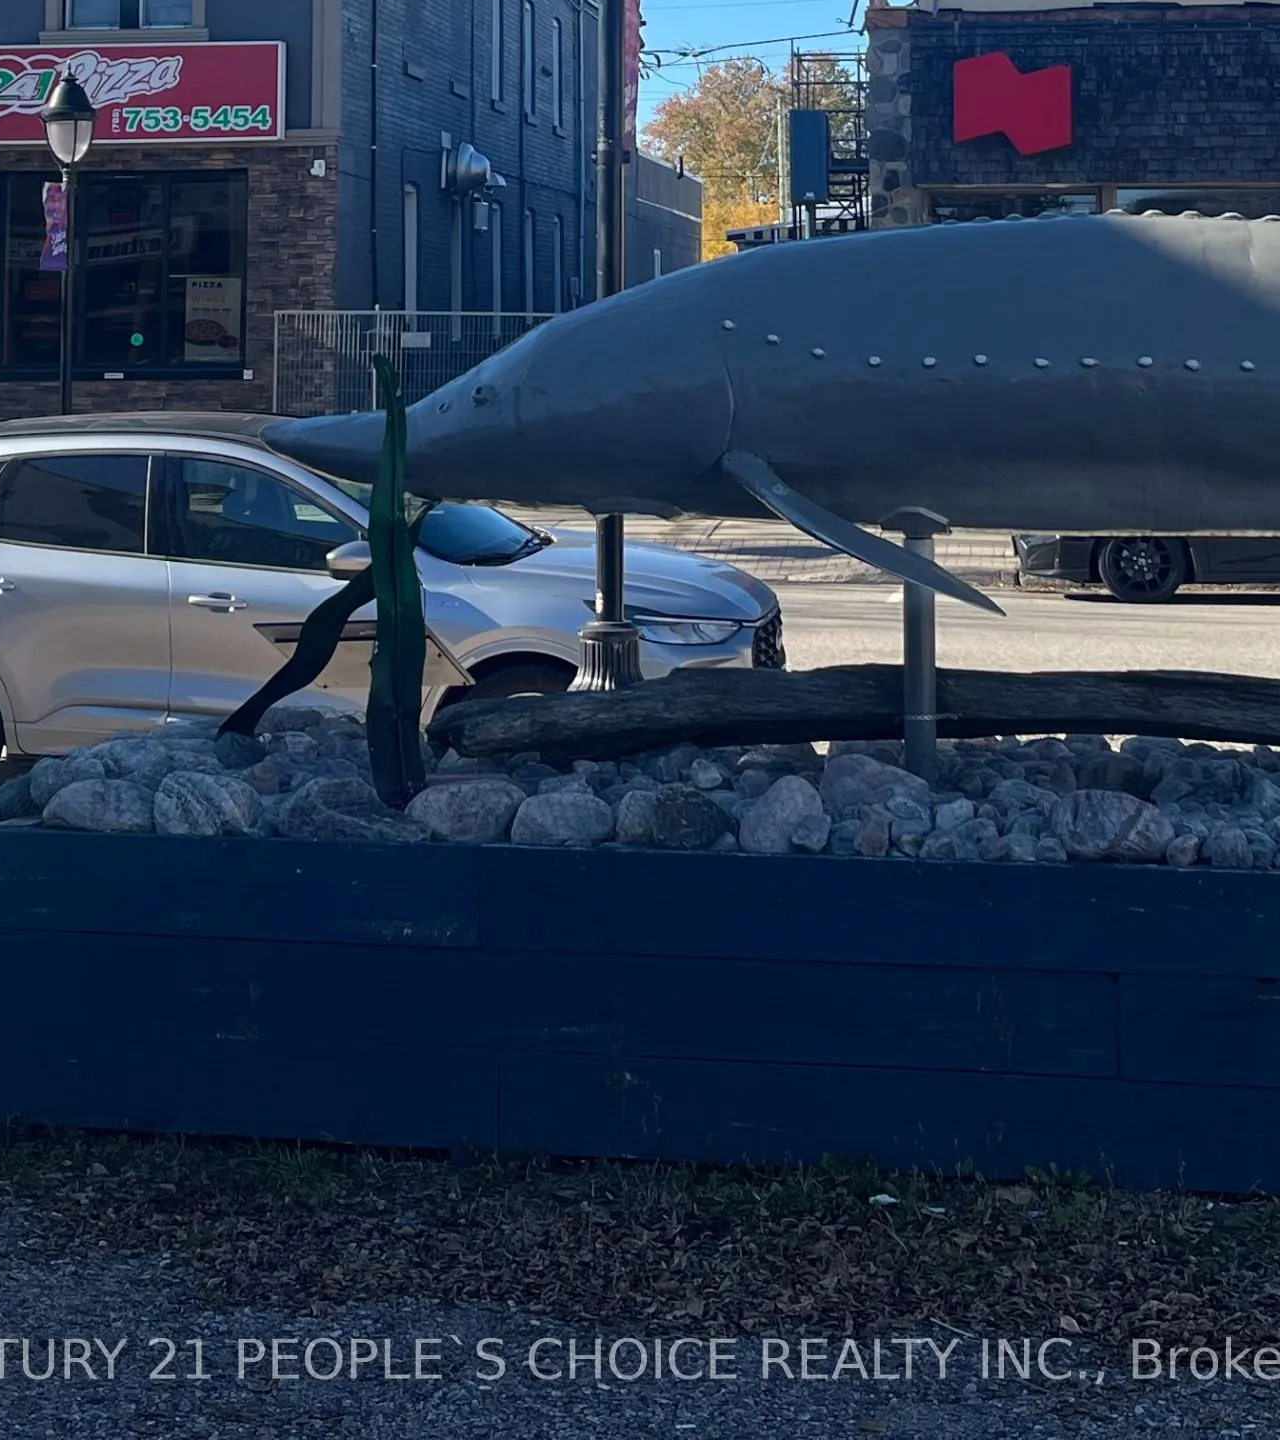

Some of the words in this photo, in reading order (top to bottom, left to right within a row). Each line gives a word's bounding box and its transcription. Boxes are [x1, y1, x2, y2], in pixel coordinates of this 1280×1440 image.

[57, 50, 183, 109] Pizza
[123, 105, 271, 132] 753-5454
[191, 281, 223, 289] PIZZA
